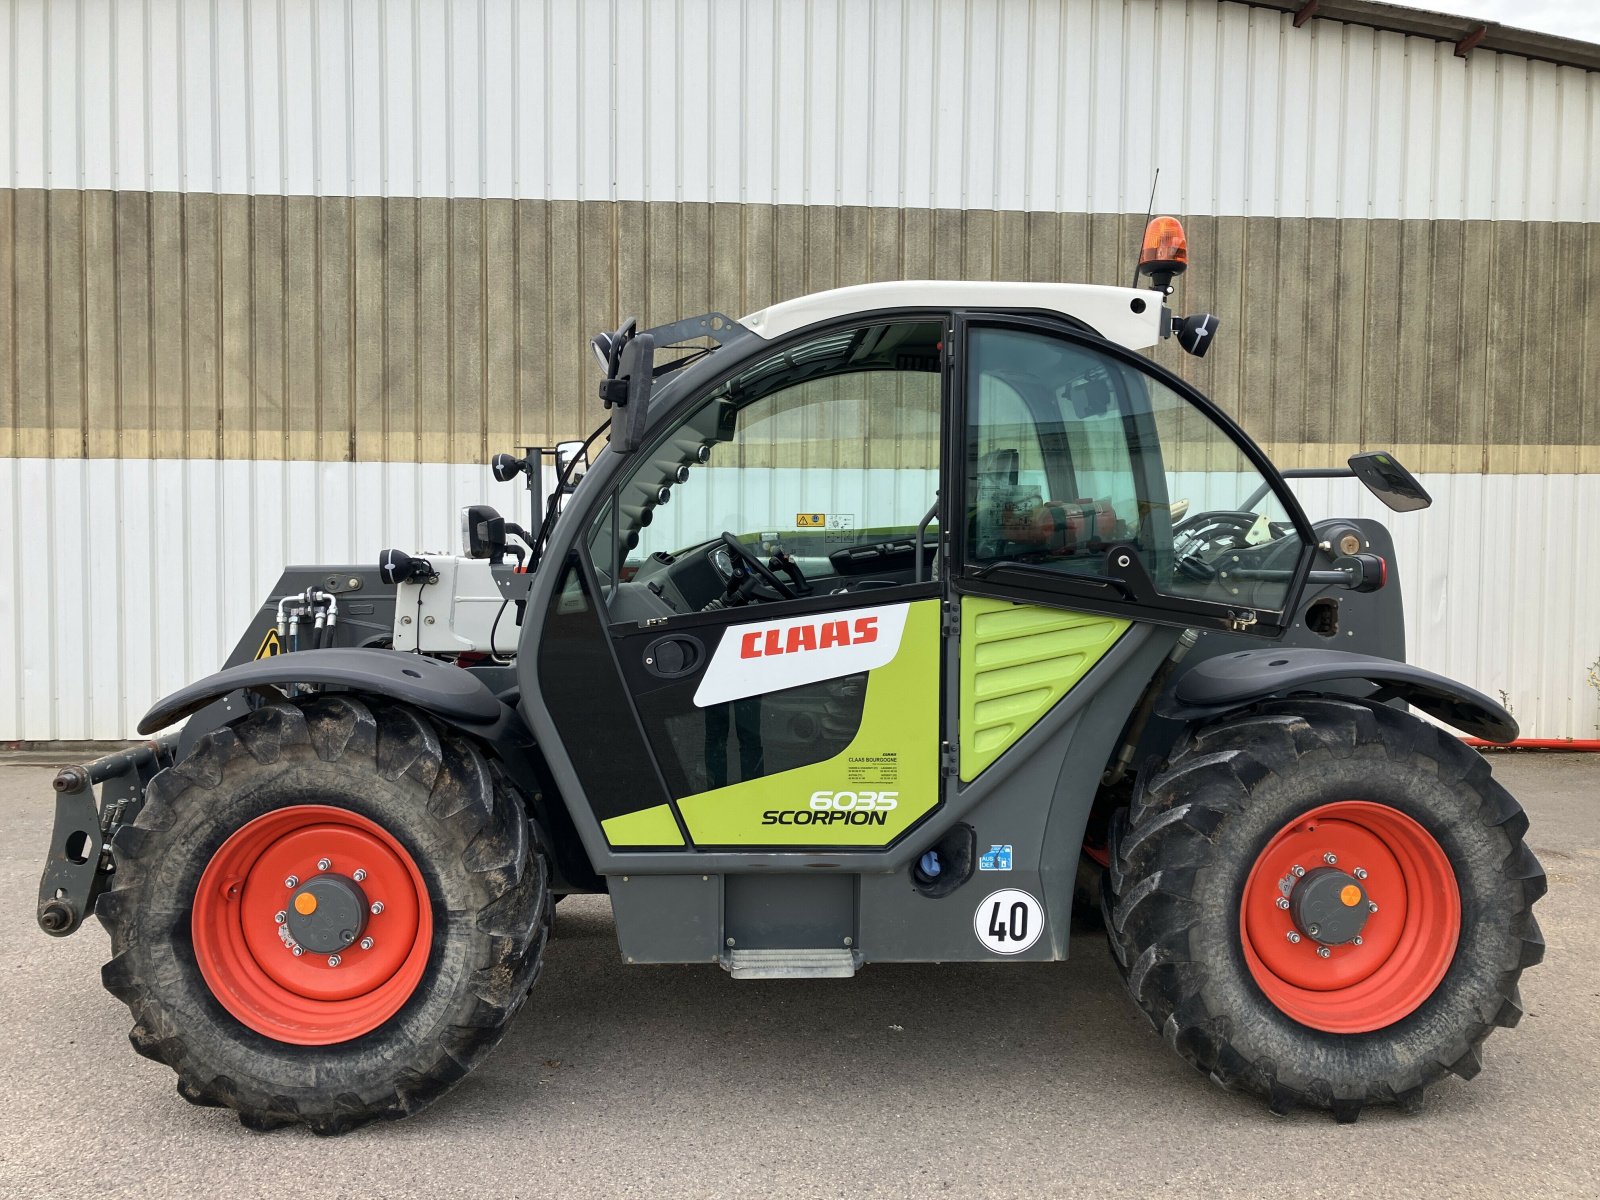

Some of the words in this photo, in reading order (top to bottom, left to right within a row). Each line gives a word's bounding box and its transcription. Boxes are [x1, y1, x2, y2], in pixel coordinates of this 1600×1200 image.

[741, 616, 878, 659] CLAAS
[809, 790, 899, 811] 6035
[761, 810, 888, 826] SCORPION
[989, 901, 1029, 942] 40
